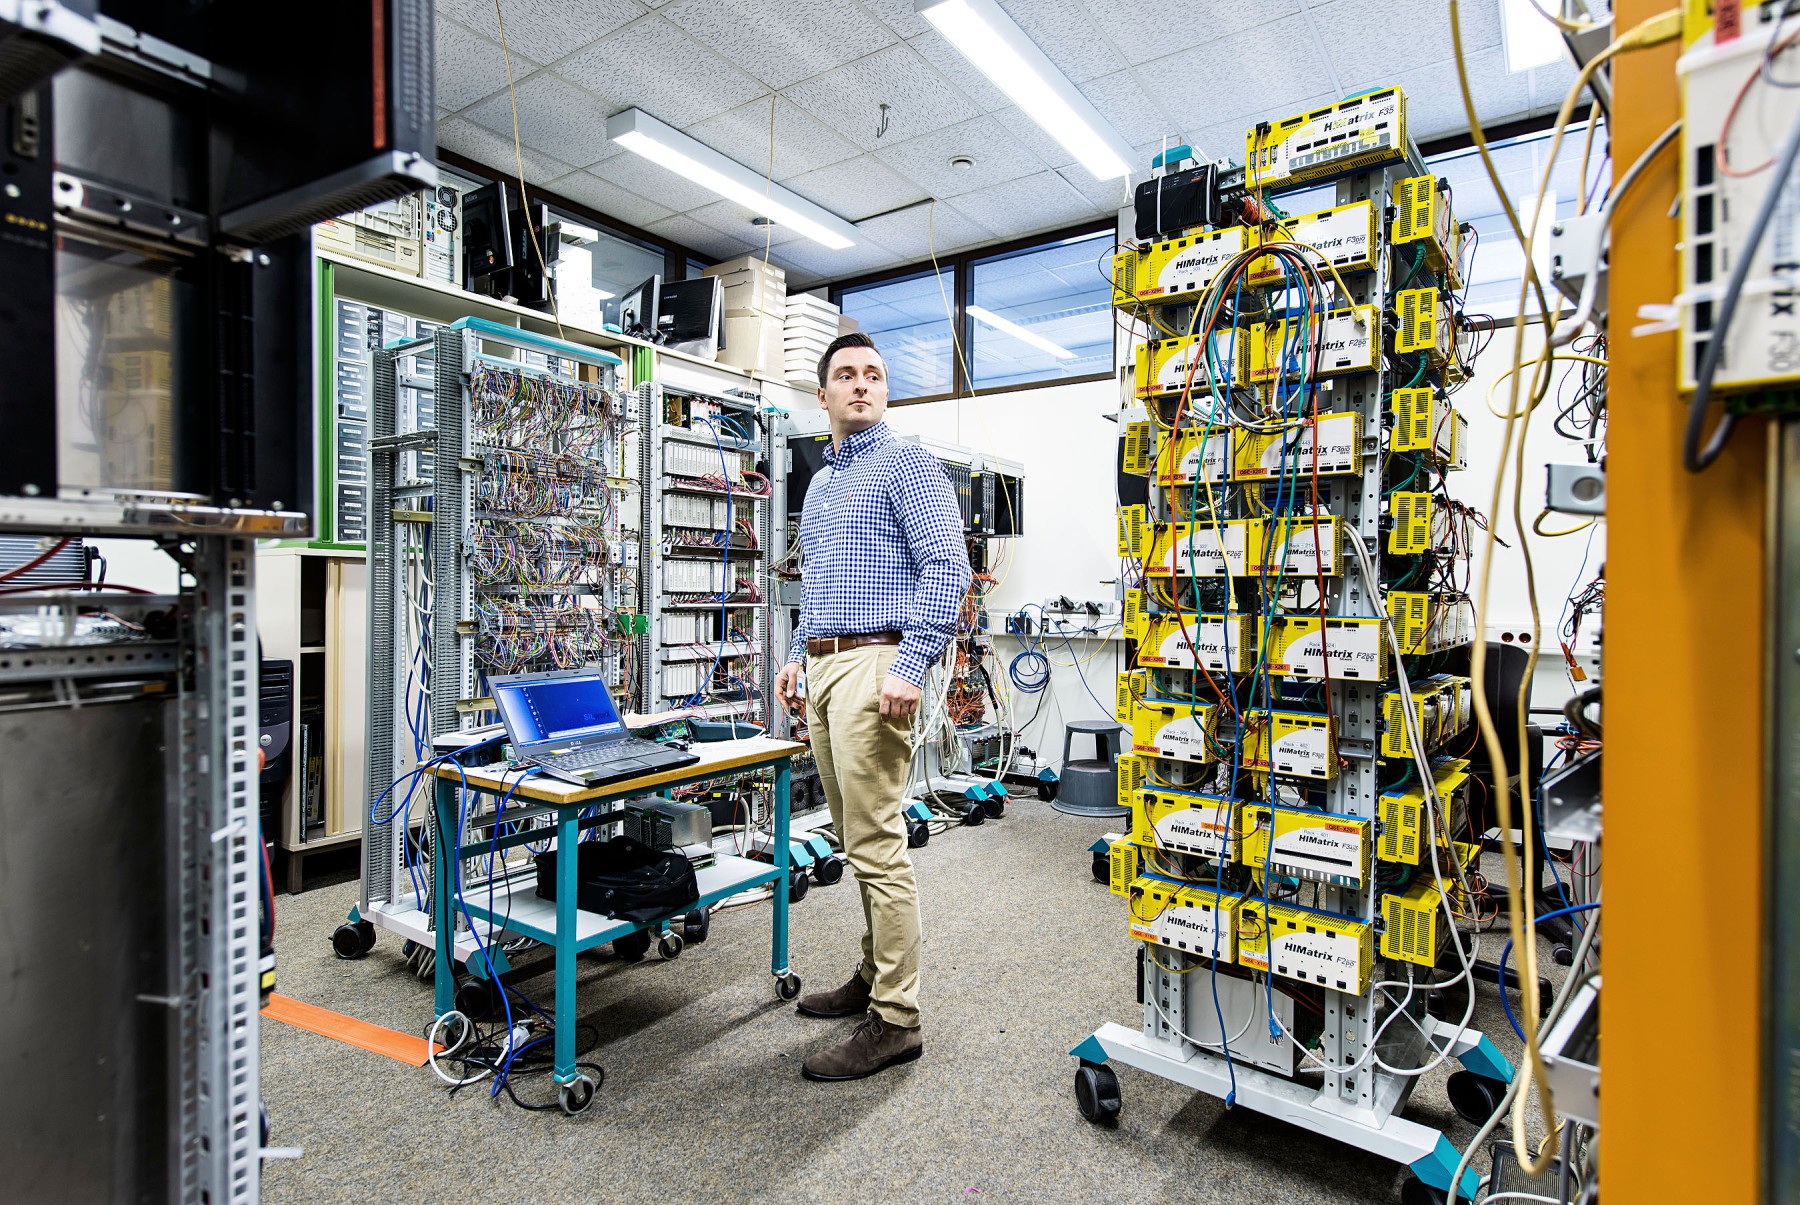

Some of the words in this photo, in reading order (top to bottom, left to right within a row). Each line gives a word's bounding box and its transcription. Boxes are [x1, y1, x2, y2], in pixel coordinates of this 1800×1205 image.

[1176, 255, 1219, 269] HIMatrix
[1163, 734, 1189, 742] HIMatrix
[1279, 747, 1310, 755] HIMatrix
[1171, 824, 1212, 839] HIMatrix
[1299, 834, 1339, 848] HIMatrix
[1167, 915, 1208, 933] HIMatrix
[1284, 942, 1333, 962] HIMatrix
